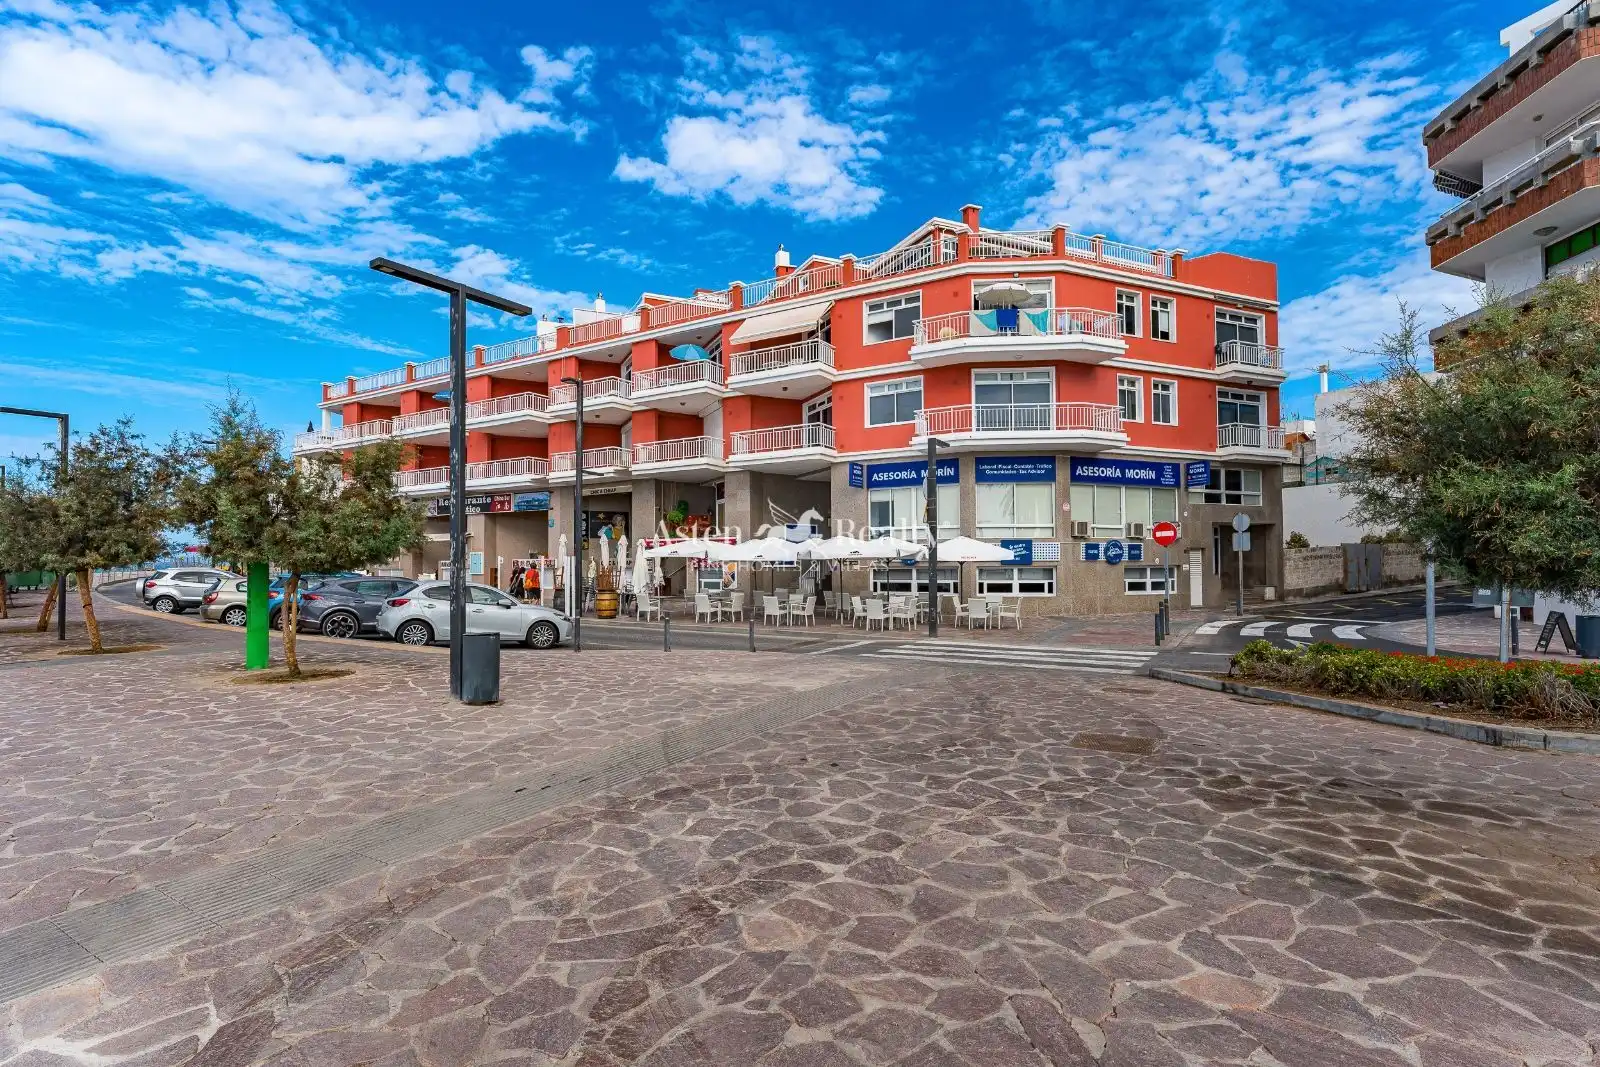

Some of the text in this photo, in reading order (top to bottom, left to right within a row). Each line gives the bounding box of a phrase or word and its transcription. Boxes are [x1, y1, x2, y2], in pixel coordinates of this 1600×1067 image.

[872, 469, 917, 481] ASESORÍA
[921, 466, 955, 477] MRÍN
[1075, 465, 1122, 478] ASESORÍA
[1125, 467, 1156, 479] MORÍN
[438, 495, 492, 506] Resrante
